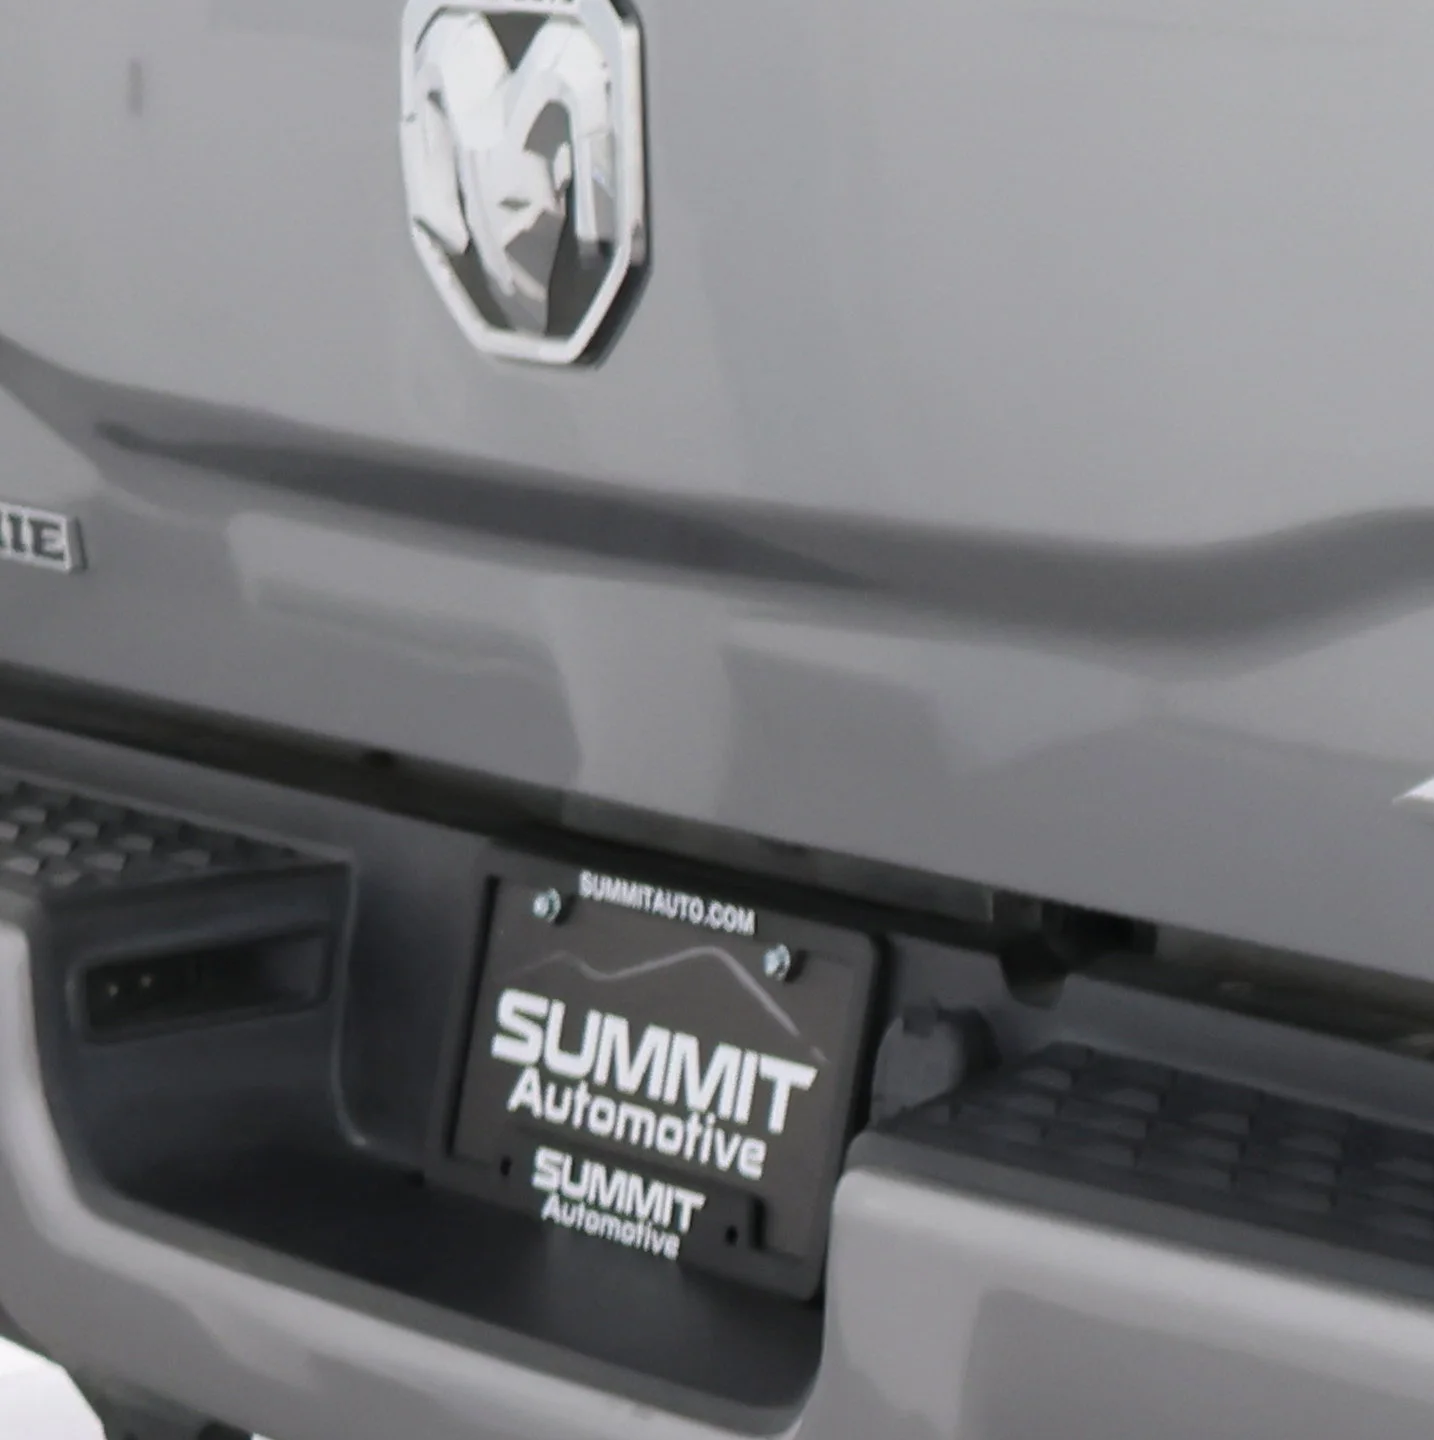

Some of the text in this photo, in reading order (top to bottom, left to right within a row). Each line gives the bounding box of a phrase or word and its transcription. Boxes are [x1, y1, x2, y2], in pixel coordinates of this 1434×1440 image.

[579, 869, 756, 936] SUMMITAUTO.COM
[491, 988, 819, 1135] SUMMIT
[507, 1066, 767, 1181] Automotive
[531, 1146, 706, 1234] SUMMIT
[541, 1193, 681, 1261] Automotive
